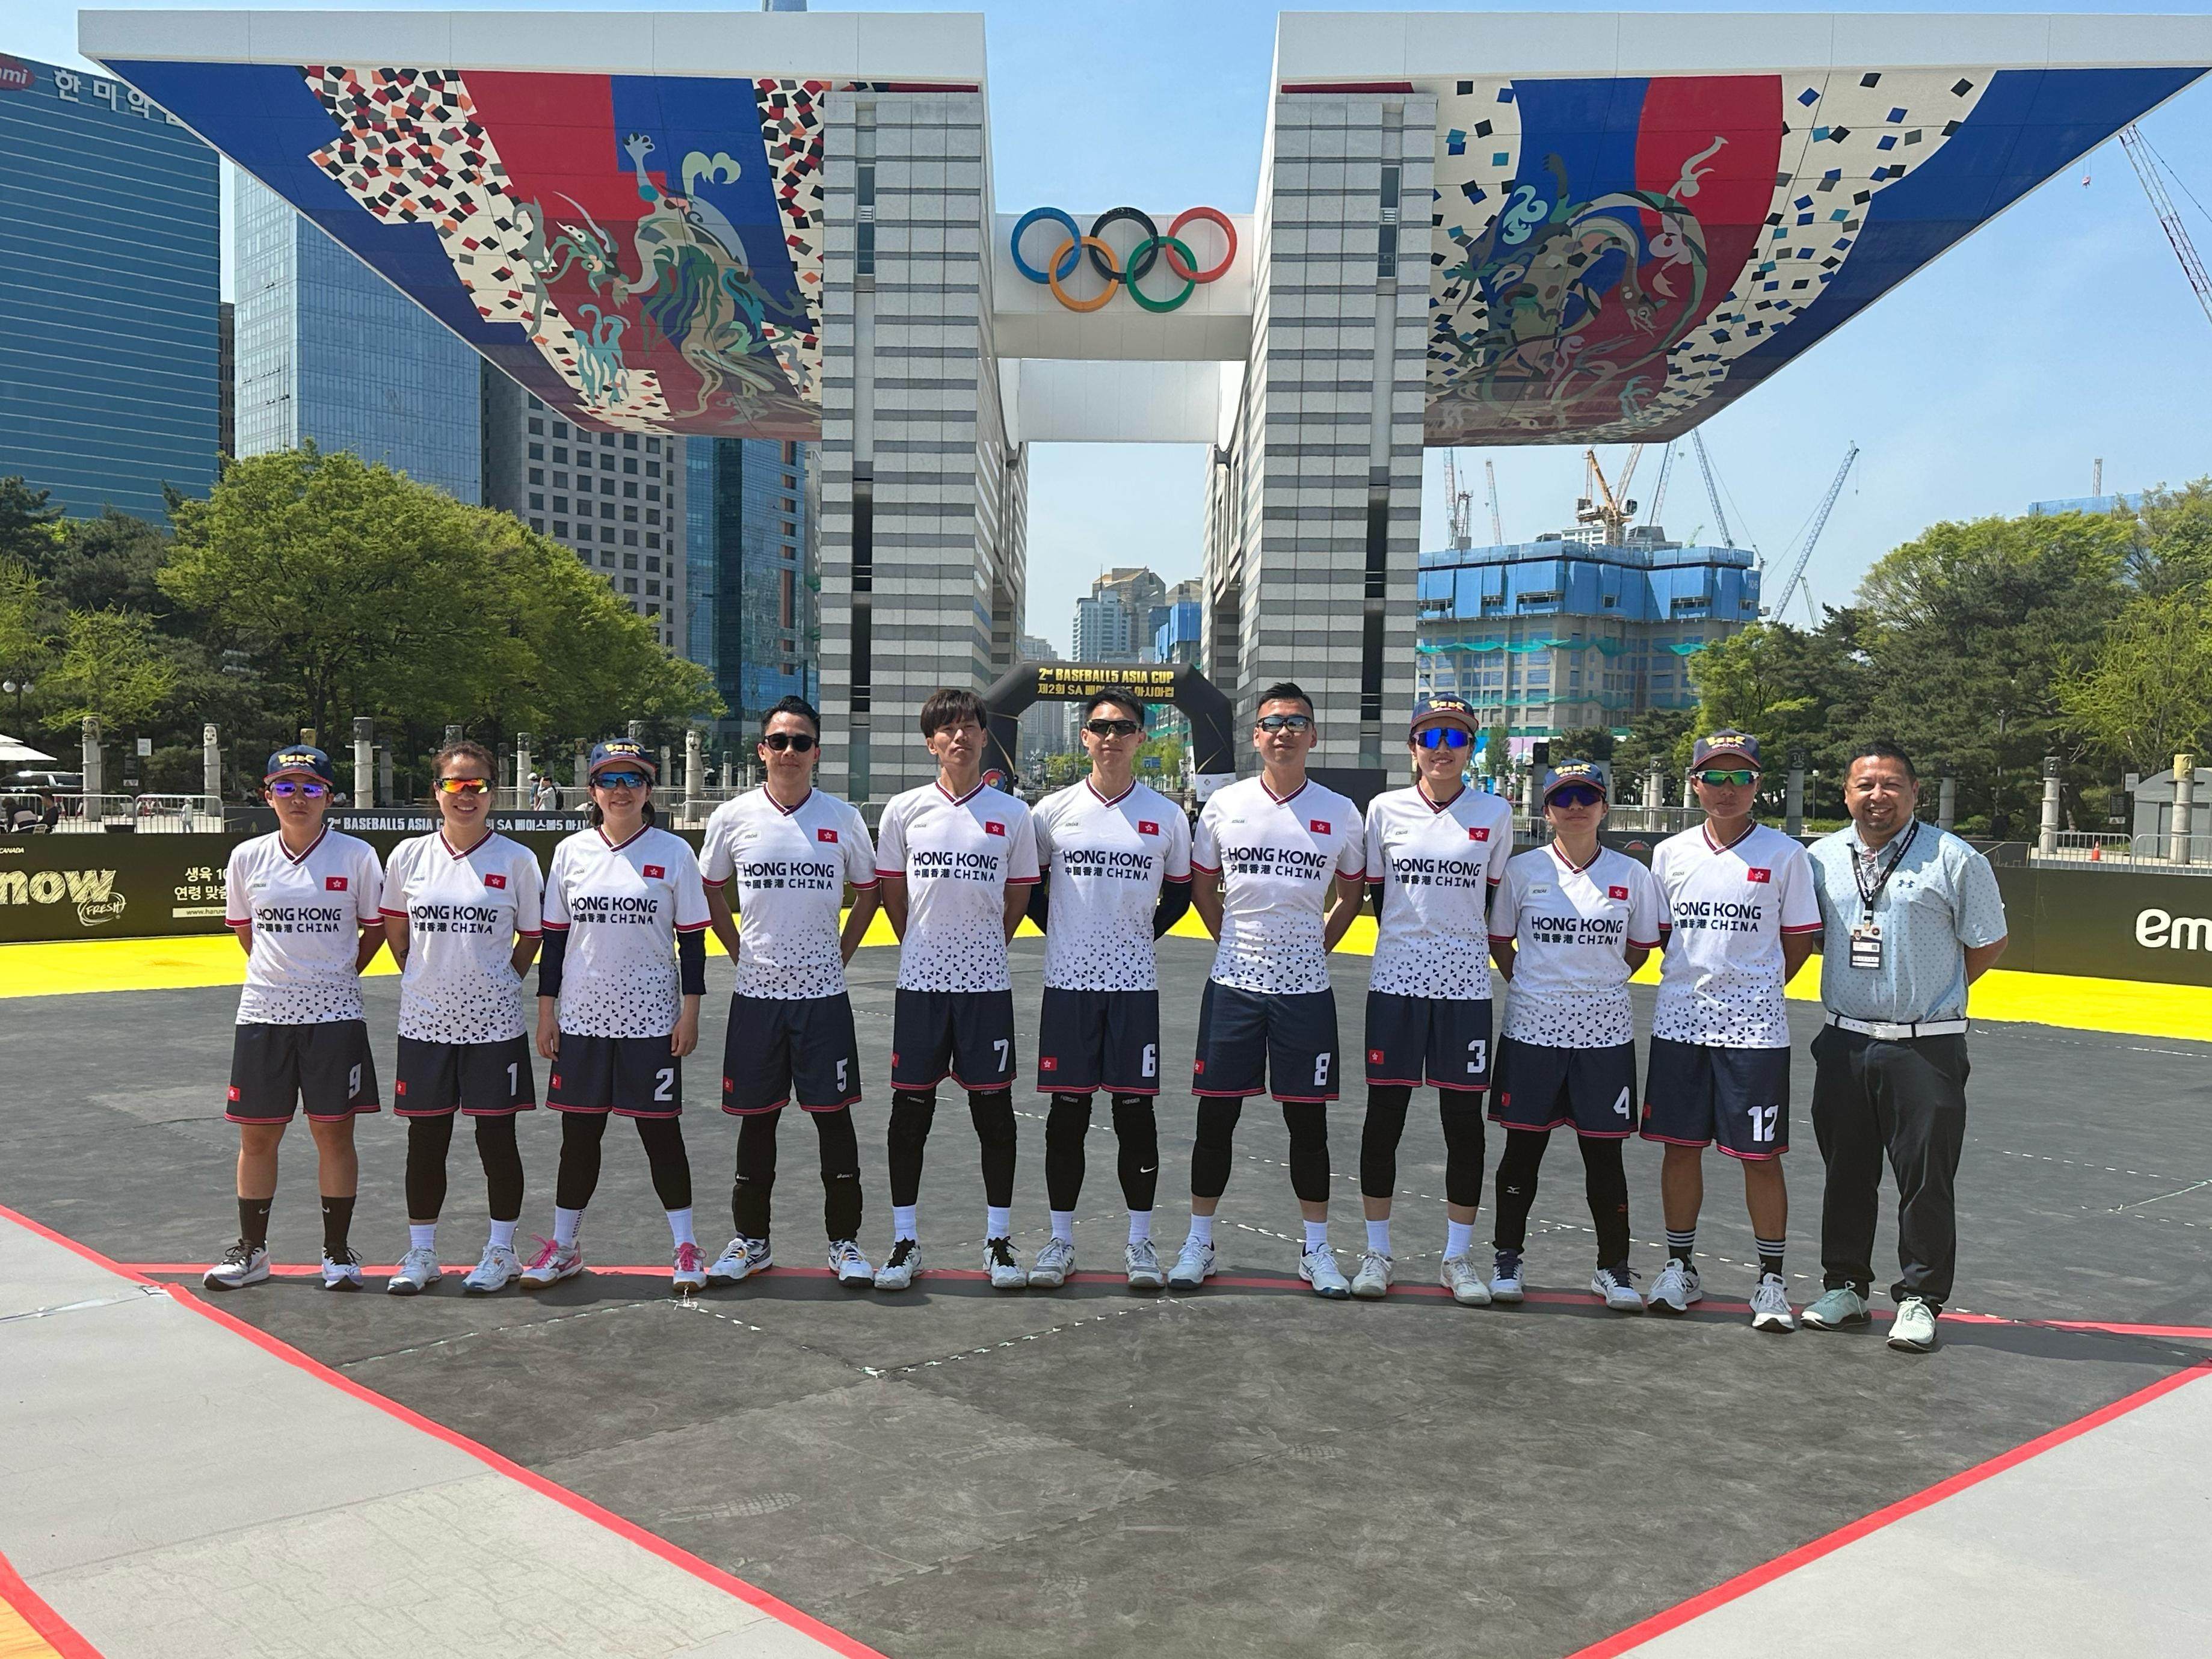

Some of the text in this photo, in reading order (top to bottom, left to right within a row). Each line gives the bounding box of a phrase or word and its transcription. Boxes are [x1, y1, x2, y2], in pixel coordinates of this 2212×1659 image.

[0, 68, 28, 84] mi
[1055, 668, 1119, 683] BASEBALL5
[1121, 671, 1148, 683] ASIA
[1151, 671, 1174, 684] CUP
[1038, 683, 1065, 695] 제2회
[1067, 685, 1083, 695] SA
[344, 817, 405, 831] BASEBALL5
[407, 817, 433, 831] ASIA
[497, 819, 513, 830] SA
[913, 852, 999, 870] HONG KONG
[1063, 850, 1153, 869] HONG KONG
[1228, 847, 1328, 868] HONG KONG
[185, 867, 213, 882] 생육
[743, 862, 834, 878] HONG KONG
[914, 869, 995, 882] 中國香港 CHINA
[1065, 866, 1148, 881] 中國香港 CHINA
[1231, 864, 1321, 881] 中國香港 CHINA
[1391, 858, 1482, 876] HONG KONG
[174, 886, 202, 900] 연령
[745, 879, 833, 890] 中國香港 CHINA
[571, 896, 658, 913] HONG KONG
[1674, 902, 1761, 920] HONG KONG
[255, 908, 342, 921] HONG KONG
[410, 905, 498, 923] HONG KONG
[610, 914, 653, 925] CHINA
[297, 923, 339, 932] CHINA
[451, 923, 493, 934] CHINA
[1532, 916, 1624, 933] HONG KONG
[1711, 920, 1758, 932] CHINA
[1533, 932, 1573, 944] 中國香港
[993, 1039, 1009, 1073] 7
[1141, 1044, 1156, 1077] 6
[1467, 1039, 1486, 1074] 3
[836, 1057, 848, 1093] 5
[1313, 1053, 1331, 1086] 8
[348, 1063, 361, 1100] 9
[507, 1062, 518, 1097] 1
[654, 1068, 674, 1101] 2
[1613, 1086, 1630, 1119] 4
[1748, 1104, 1779, 1142] 12
